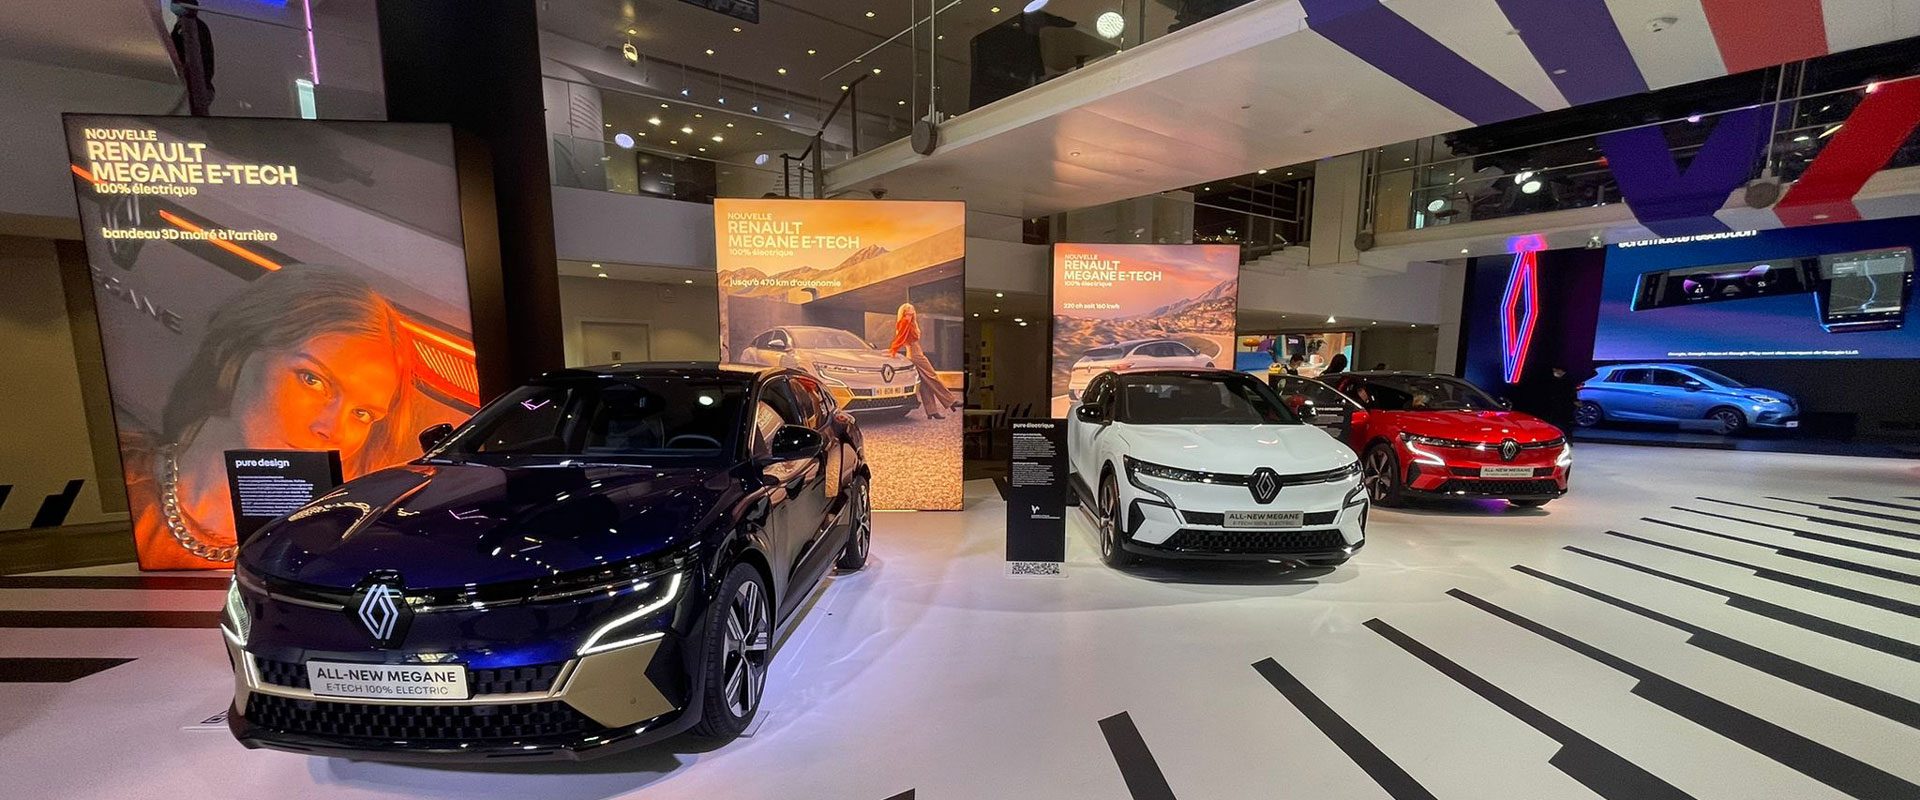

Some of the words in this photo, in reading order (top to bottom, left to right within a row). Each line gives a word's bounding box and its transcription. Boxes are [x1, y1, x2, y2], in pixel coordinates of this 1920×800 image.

[85, 128, 158, 141] NOUVELLE
[86, 140, 207, 163] RENAULT
[91, 162, 205, 184] MEGANE
[206, 164, 299, 186] E-TECH
[94, 183, 132, 194] 100%
[132, 183, 198, 198] électrique
[727, 212, 773, 220] NOUVELLE
[727, 220, 803, 235] RENAULT
[102, 227, 160, 240] bandeau
[161, 229, 179, 240] 3D
[179, 228, 218, 241] moiré
[219, 229, 228, 241] à
[228, 228, 278, 242] l'arrière
[728, 235, 799, 249] MEGANE
[801, 235, 860, 249] E-TECH
[729, 248, 751, 256] 100%
[752, 248, 794, 258] électrique
[1064, 260, 1120, 271] RENAULT
[1064, 270, 1116, 281] MEGANE
[1118, 271, 1162, 281] E-TECH
[730, 278, 759, 287] jusqu'à
[760, 279, 775, 287] 470
[776, 279, 789, 287] km
[790, 279, 841, 288] d'autonomie
[235, 459, 257, 469] pure
[258, 458, 290, 469] design
[317, 668, 384, 682] ALL-NEW
[387, 670, 457, 683] MEGANE
[326, 682, 363, 693] E-TECH
[365, 685, 393, 694] 100%
[396, 686, 449, 695] ELECTRIC
